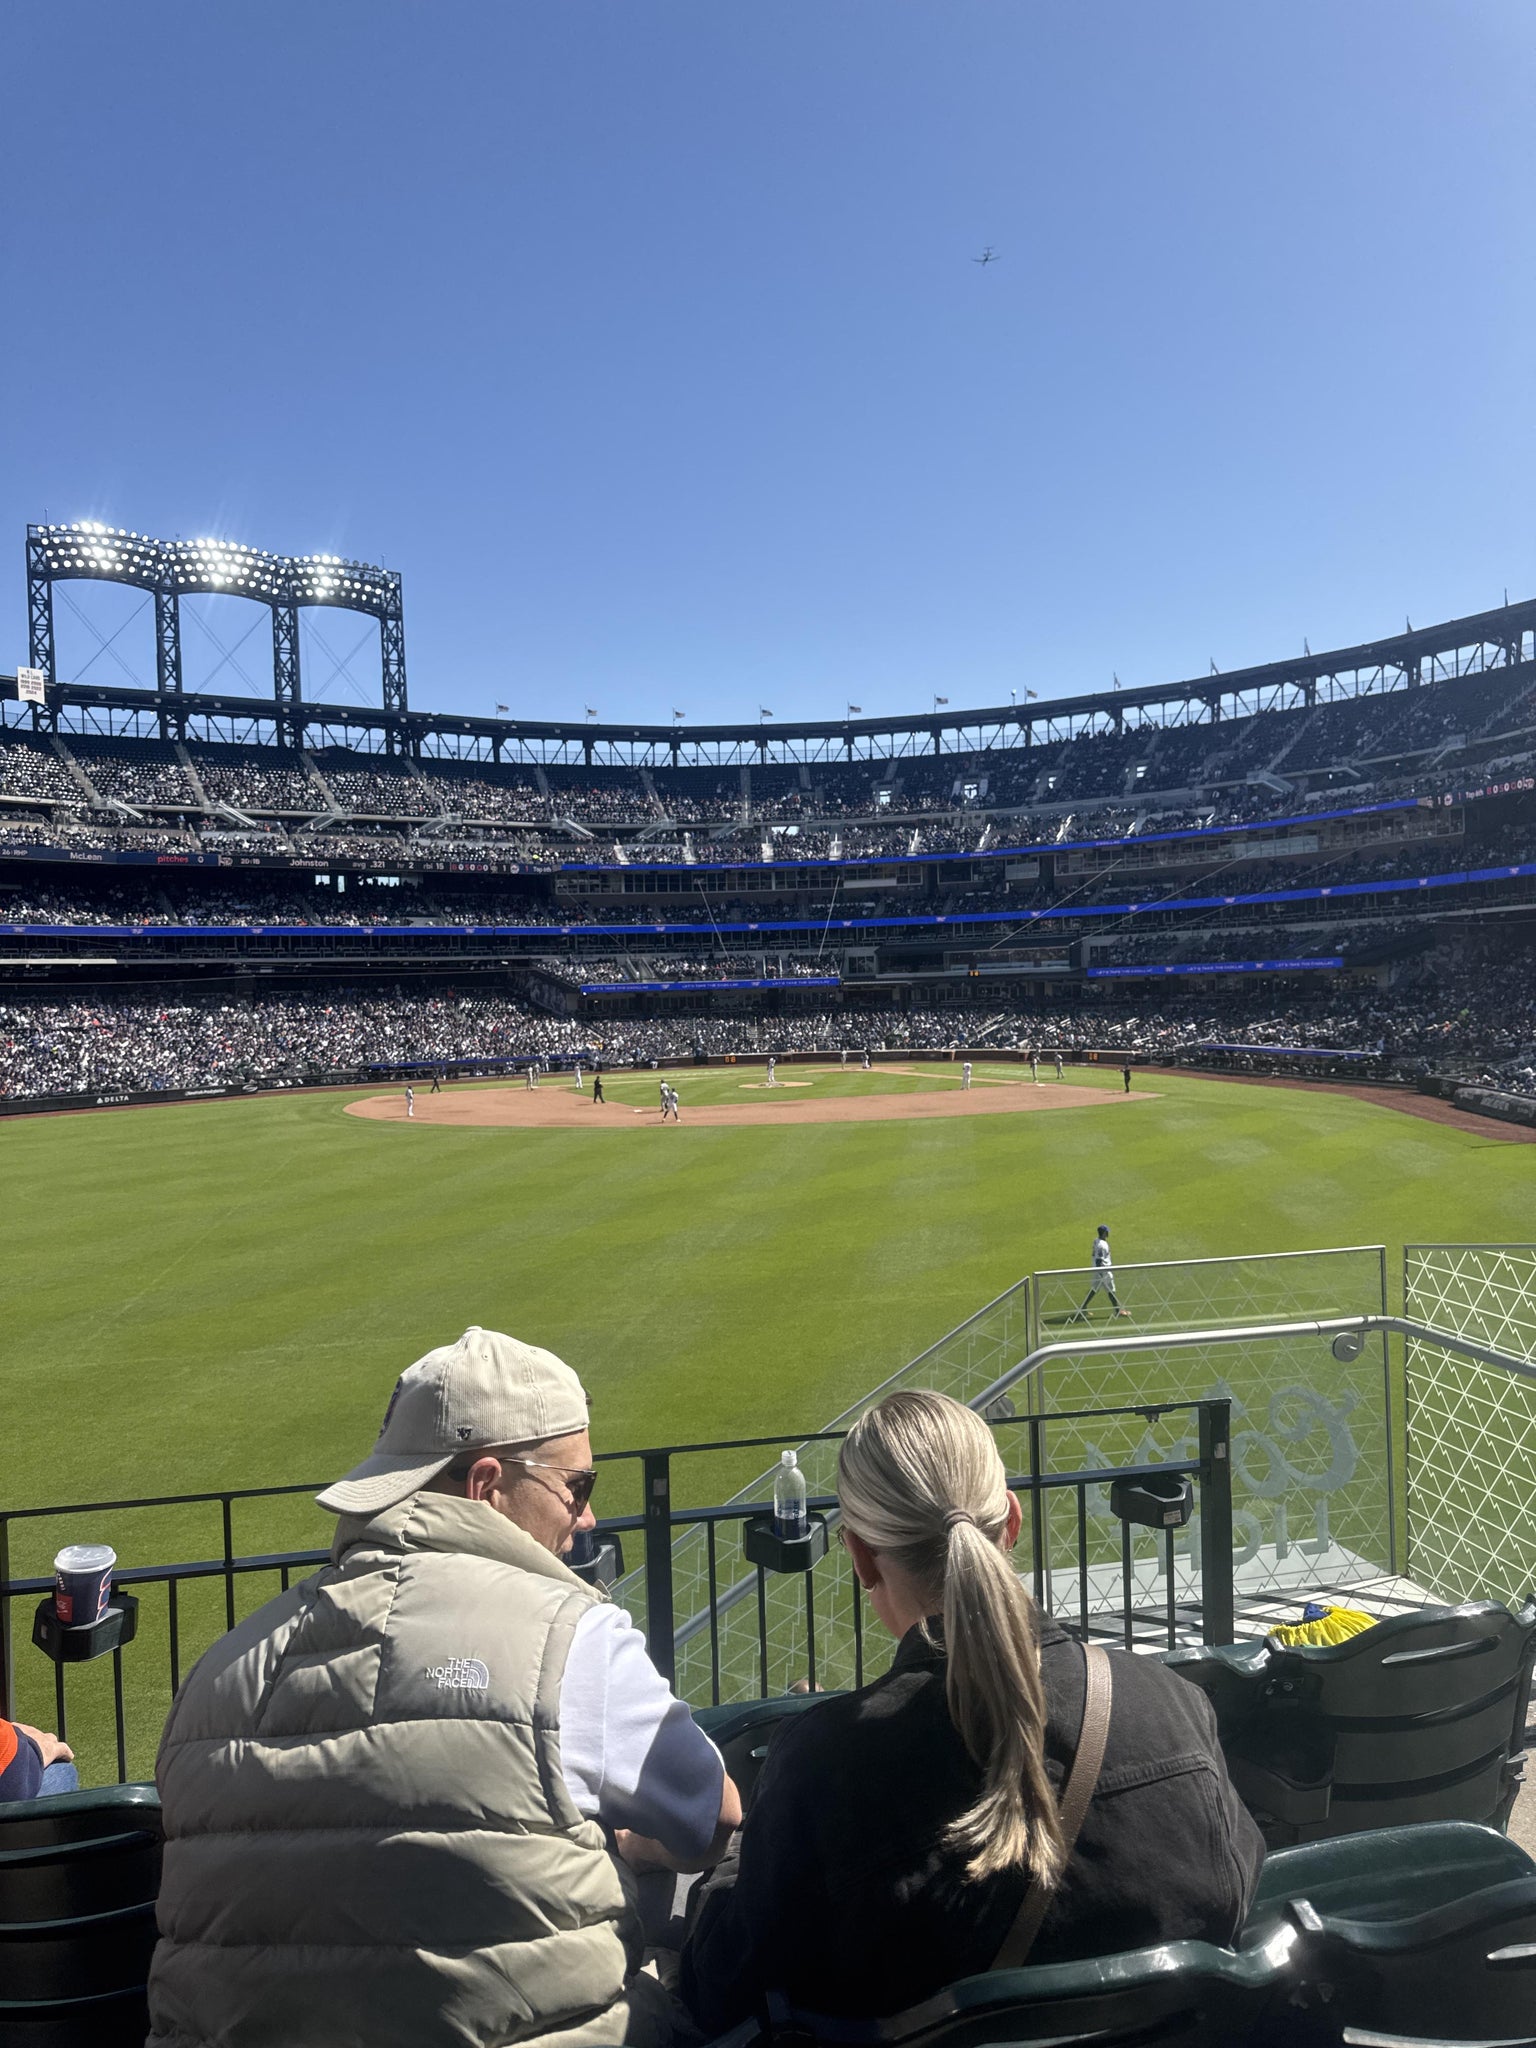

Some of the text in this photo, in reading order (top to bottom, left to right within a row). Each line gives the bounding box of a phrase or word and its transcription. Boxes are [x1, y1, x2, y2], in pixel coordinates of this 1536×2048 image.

[70, 852, 102, 861] McLean
[157, 855, 189, 864] pitches
[289, 859, 329, 867] Johnston
[352, 862, 367, 870] avg
[370, 861, 385, 869] .321
[104, 1095, 129, 1103] DELTA
[447, 1657, 472, 1668] THE
[425, 1667, 470, 1678] NORTH
[437, 1676, 468, 1688] FACE
